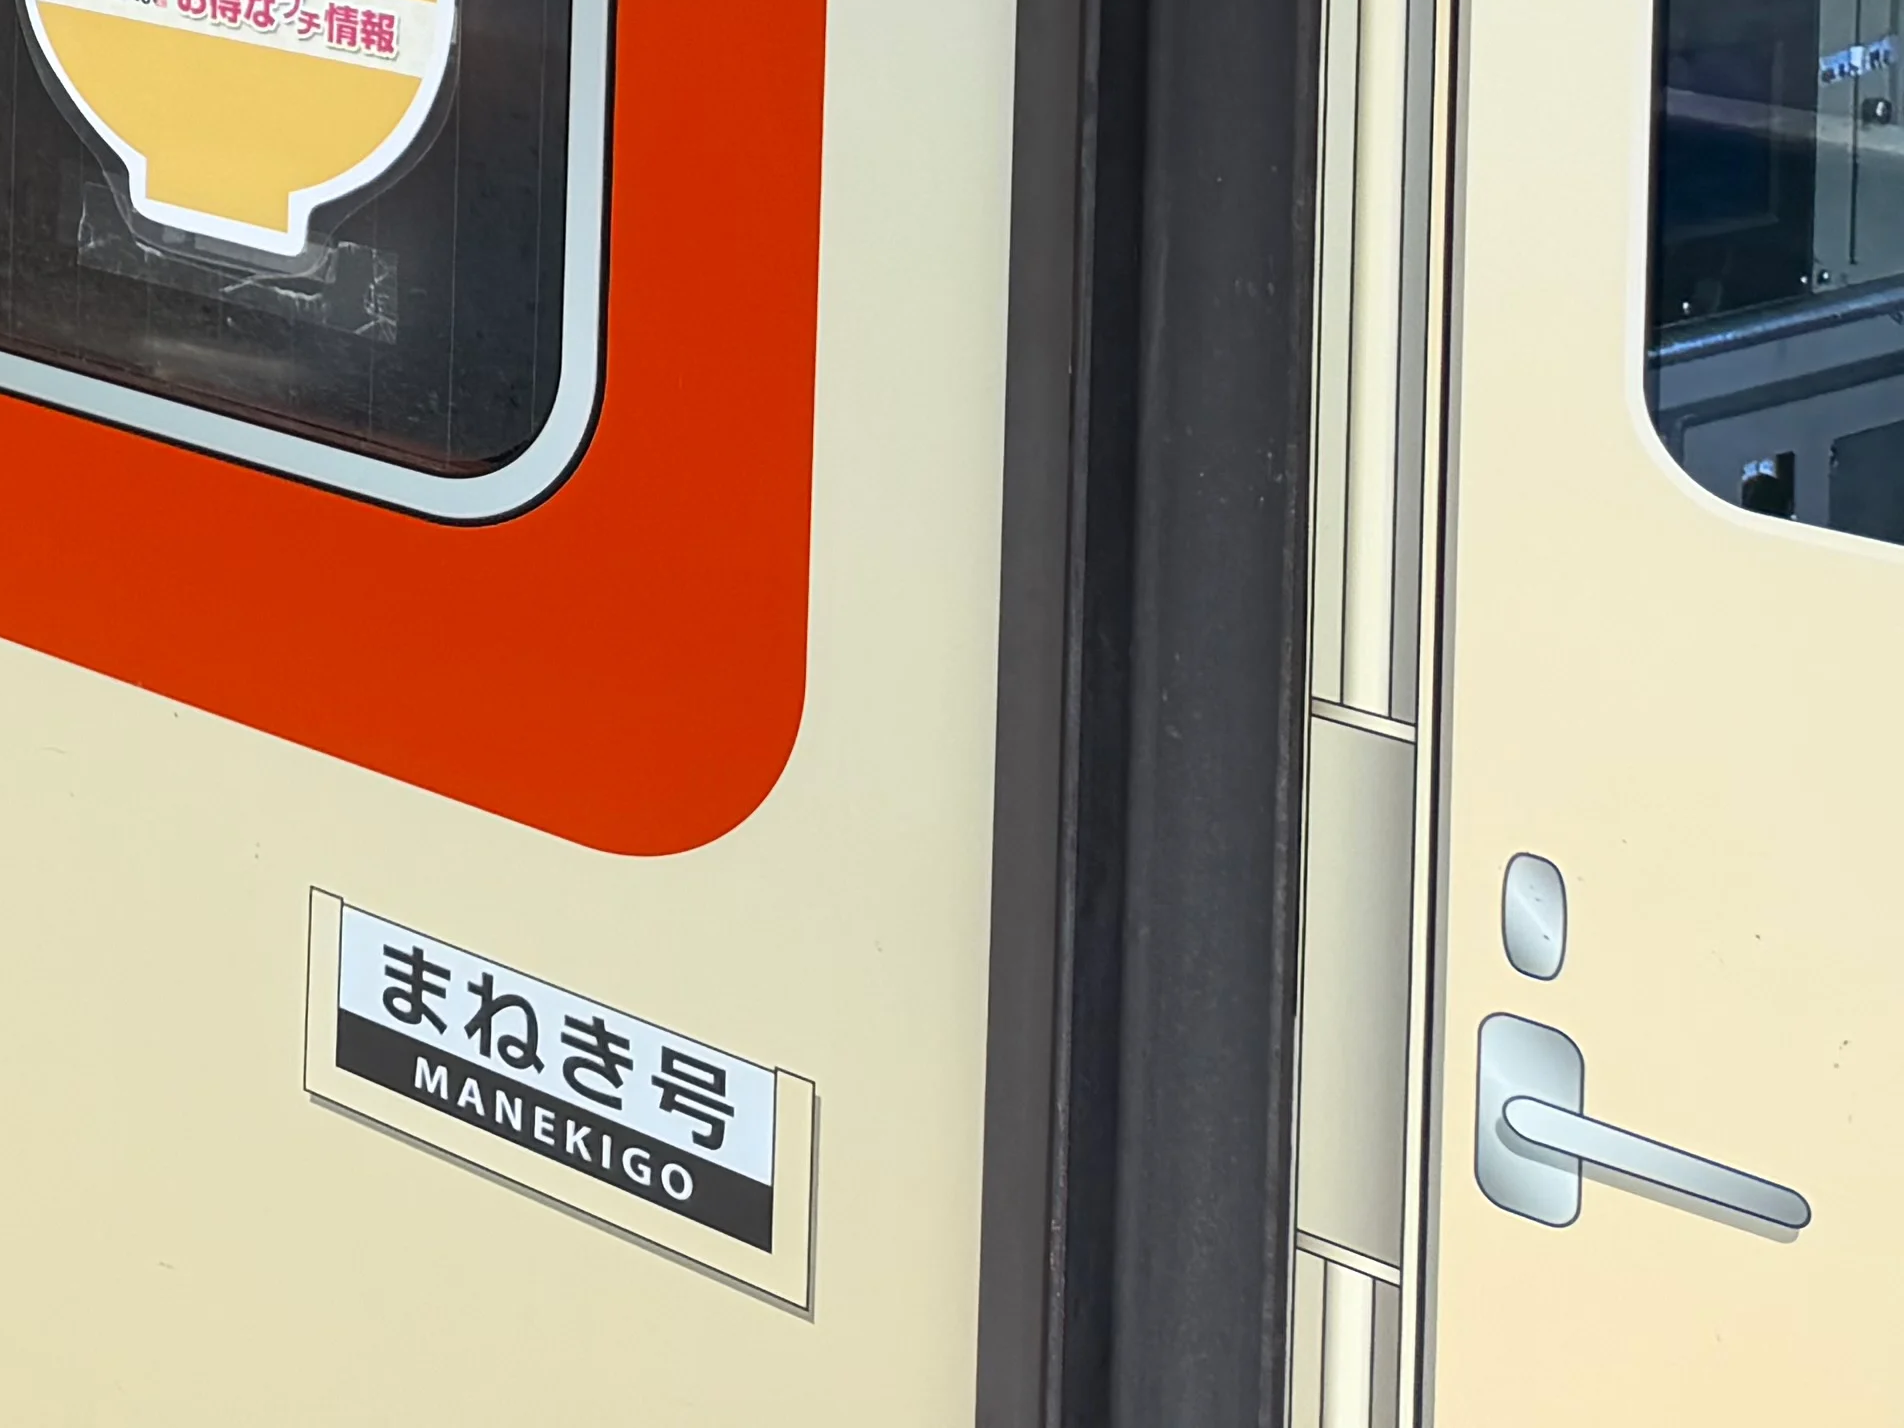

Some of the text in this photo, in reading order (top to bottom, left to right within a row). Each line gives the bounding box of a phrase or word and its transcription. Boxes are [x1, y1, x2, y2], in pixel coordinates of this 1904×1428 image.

[382, 943, 735, 1151] まねき号
[414, 1056, 694, 1200] MANEKIGO
